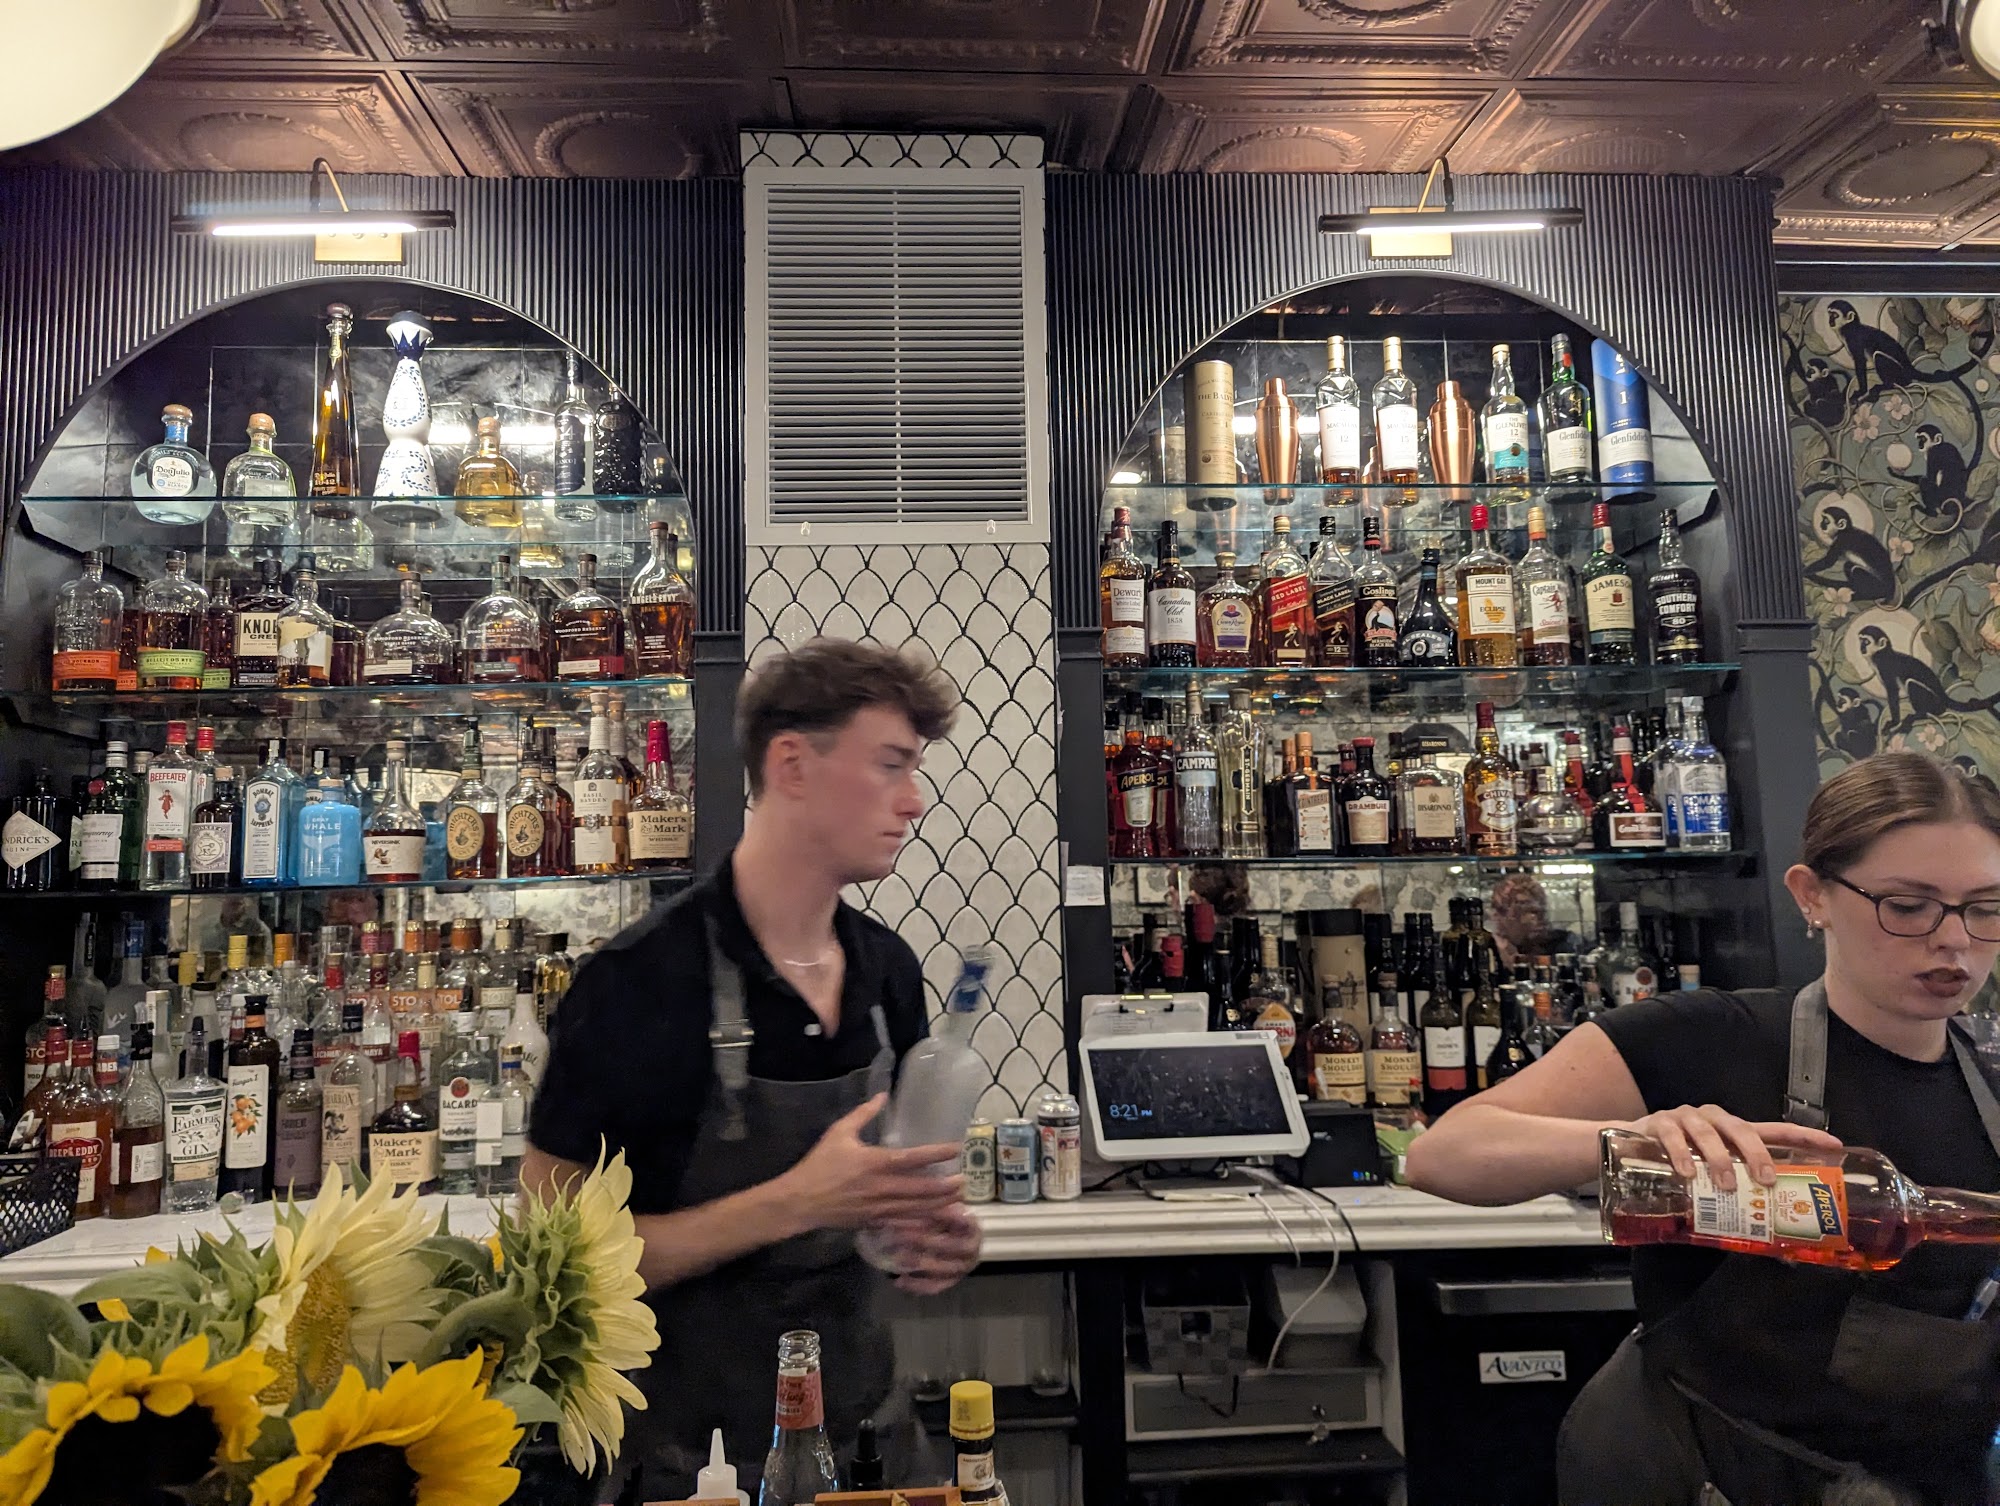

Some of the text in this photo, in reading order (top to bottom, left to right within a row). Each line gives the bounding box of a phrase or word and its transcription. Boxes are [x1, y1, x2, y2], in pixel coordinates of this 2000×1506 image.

[1212, 391, 1234, 401] BALVE
[1510, 428, 1519, 436] 12
[1339, 434, 1349, 443] 12
[156, 464, 191, 478] Don Julio
[1113, 587, 1142, 598] Dewar's
[1271, 585, 1307, 602] RED LABEL
[1532, 584, 1557, 596] Captain
[1156, 595, 1192, 606] Canadian
[1316, 588, 1354, 605] BLACK LABEL
[1655, 592, 1698, 608] SOUTHERN
[1164, 605, 1184, 616] Club
[1480, 605, 1507, 613] ECLIPSE
[1658, 602, 1696, 616] COMFORT
[1231, 618, 1246, 626] Royal
[1671, 617, 1686, 625] 80
[554, 626, 582, 634] WOODFORD
[1176, 757, 1218, 770] CAMPAR
[150, 772, 187, 783] BEEFEATER
[1120, 773, 1155, 790] APEROL
[252, 788, 275, 798] BOMBAY
[1348, 802, 1388, 811] DRAMBUIE
[1417, 804, 1452, 812] DISARONNO
[250, 818, 274, 828] SAPPHIRE
[640, 814, 687, 824] Maker's
[303, 822, 341, 830] WHALE
[653, 824, 687, 833] Mark
[4, 835, 51, 845] NDRICK'S
[1324, 1056, 1360, 1064] MONKEY
[1384, 1055, 1416, 1064] MONKEY
[1109, 1103, 1153, 1119] 8:21 PM
[372, 1138, 422, 1148] Maker's
[75, 1144, 100, 1156] EDDY
[182, 1142, 210, 1156] GIN
[384, 1147, 421, 1158] Mark
[1812, 1186, 1837, 1232] APEROL
[1484, 1356, 1562, 1378] AVANTCO
